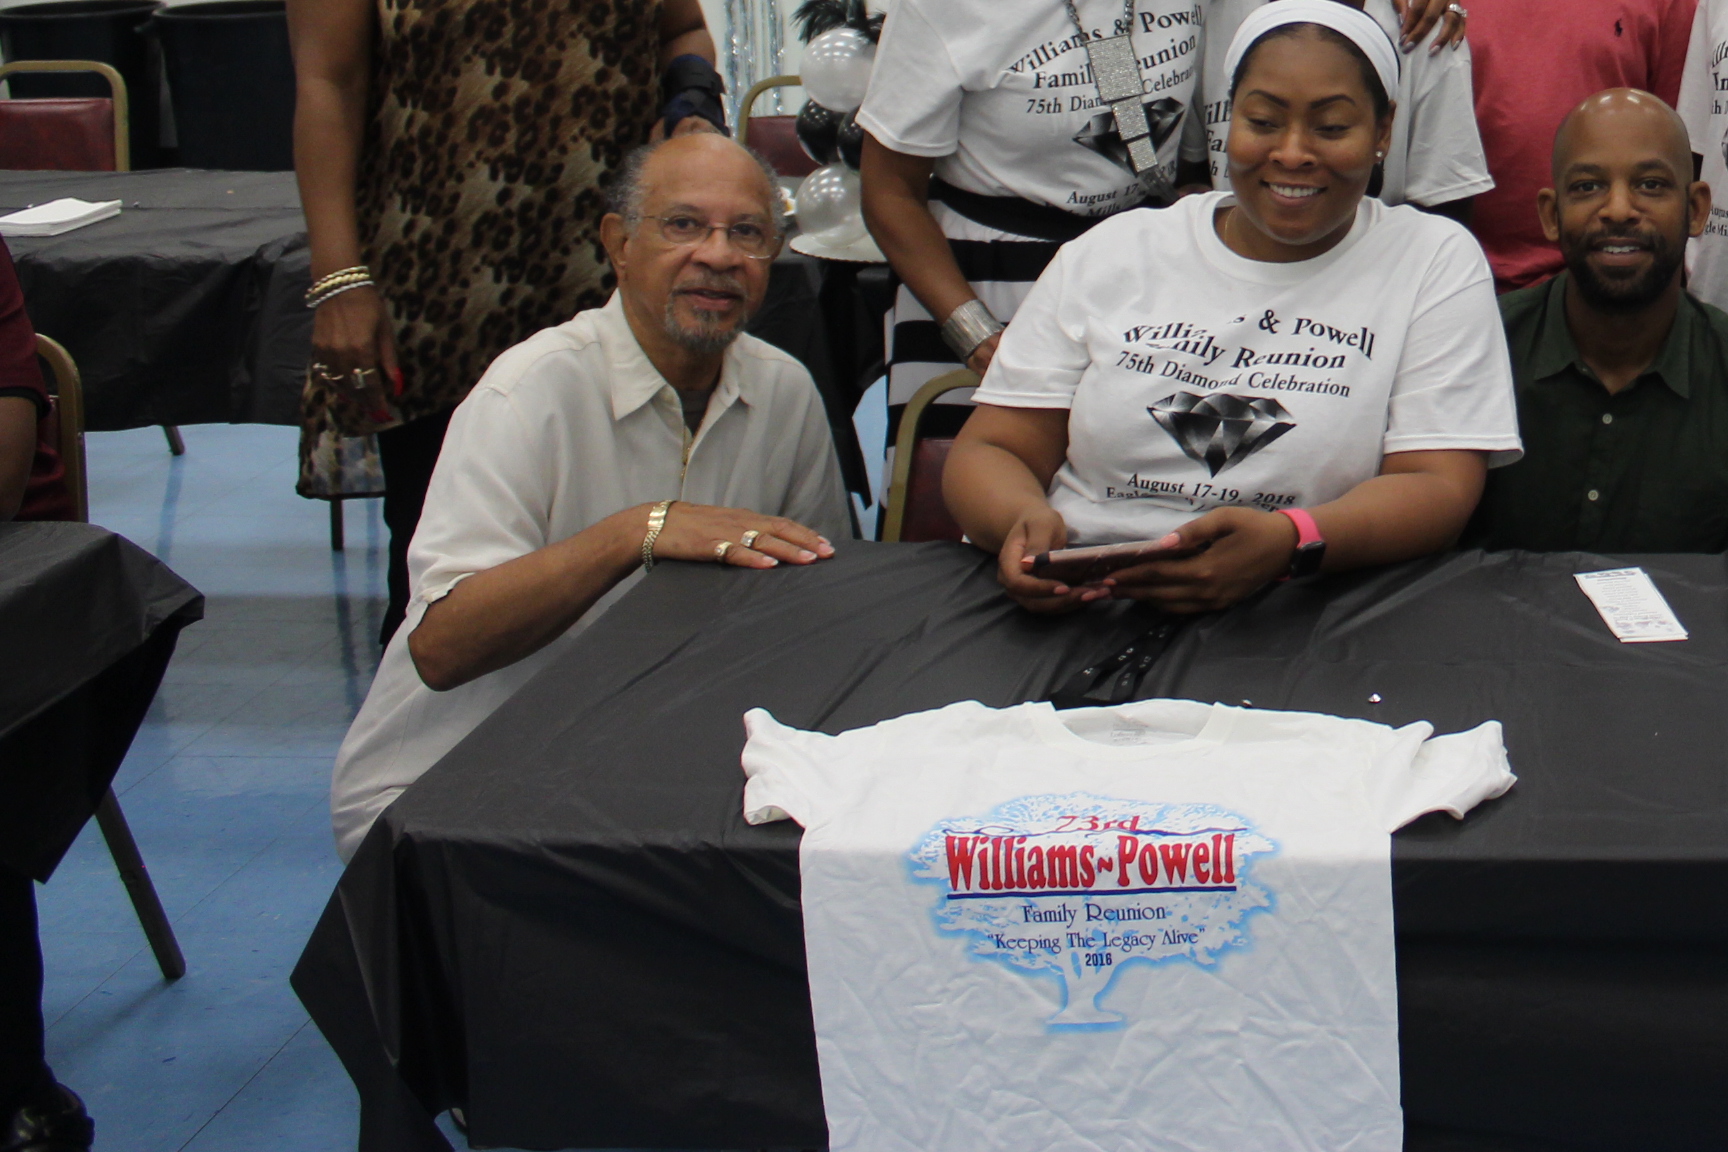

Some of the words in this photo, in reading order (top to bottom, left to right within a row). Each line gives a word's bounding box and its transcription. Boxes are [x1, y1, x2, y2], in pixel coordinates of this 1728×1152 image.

[1138, 4, 1203, 34] Powell
[1033, 63, 1098, 89] Famil
[1135, 34, 1196, 70] eunion
[1026, 96, 1062, 114] 75th
[1066, 189, 1117, 206] August
[1123, 314, 1246, 343] Willis
[1258, 309, 1281, 335] &
[1290, 317, 1375, 361] Powell
[1230, 346, 1346, 369] Reunion
[1115, 350, 1154, 375] 75th
[1159, 359, 1243, 390] Diamond
[1248, 371, 1351, 398] Celebration
[1127, 473, 1185, 494] August
[1252, 492, 1296, 506] 2018
[1055, 815, 1140, 832] 73rd
[1022, 903, 1077, 928] Family
[1085, 902, 1166, 922] Reunion
[1066, 932, 1096, 948] The
[1102, 932, 1156, 952] Legacy
[1085, 953, 1113, 966] 2016
